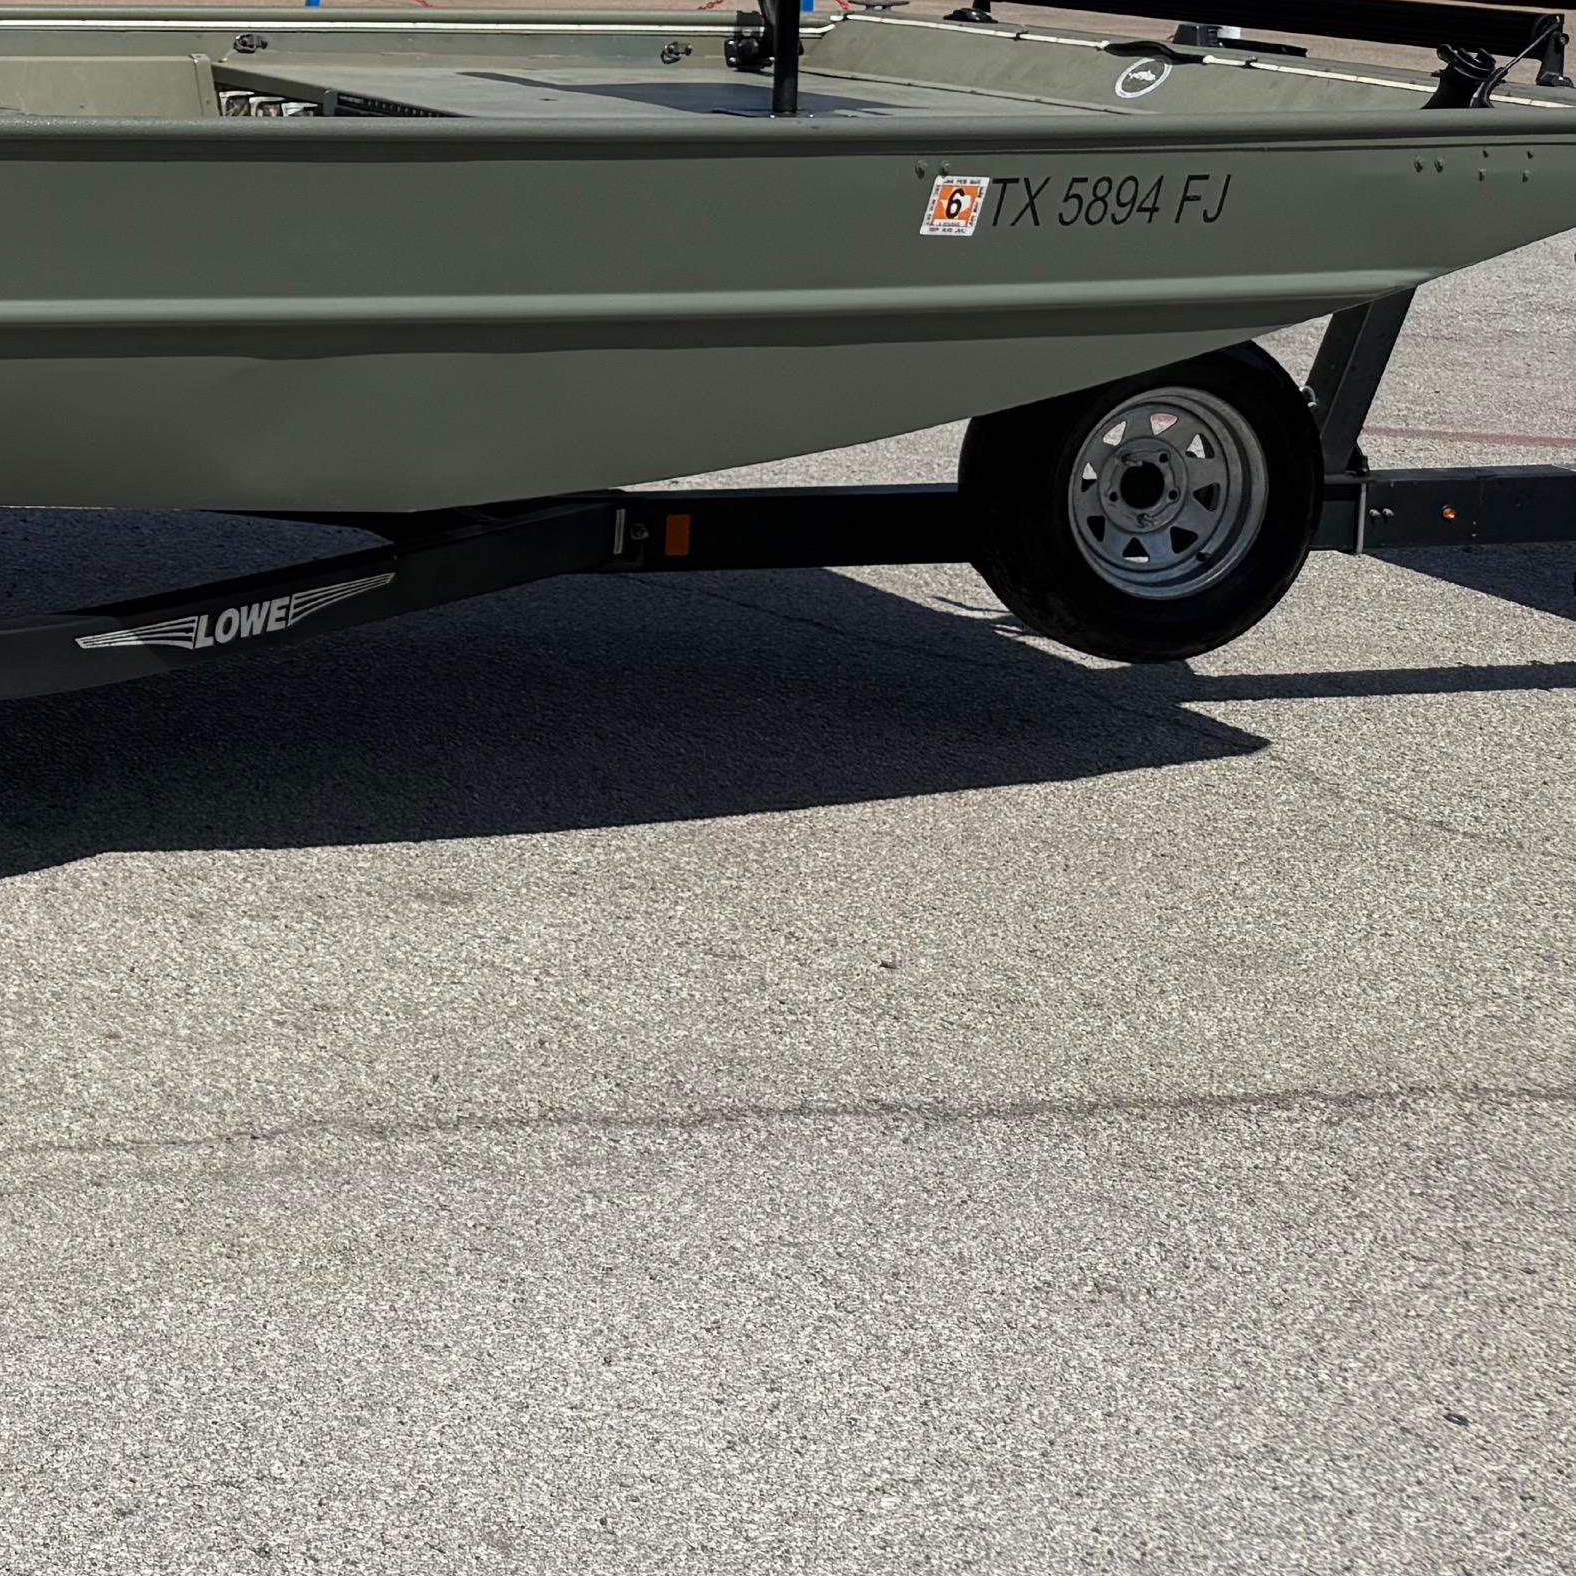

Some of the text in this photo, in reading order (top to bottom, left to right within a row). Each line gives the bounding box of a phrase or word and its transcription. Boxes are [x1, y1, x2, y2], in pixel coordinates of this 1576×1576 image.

[946, 188, 965, 219] 6
[991, 177, 1051, 226] TX
[1058, 174, 1164, 226] 5894
[1174, 174, 1232, 224] FJ
[195, 596, 290, 649] LOWE
